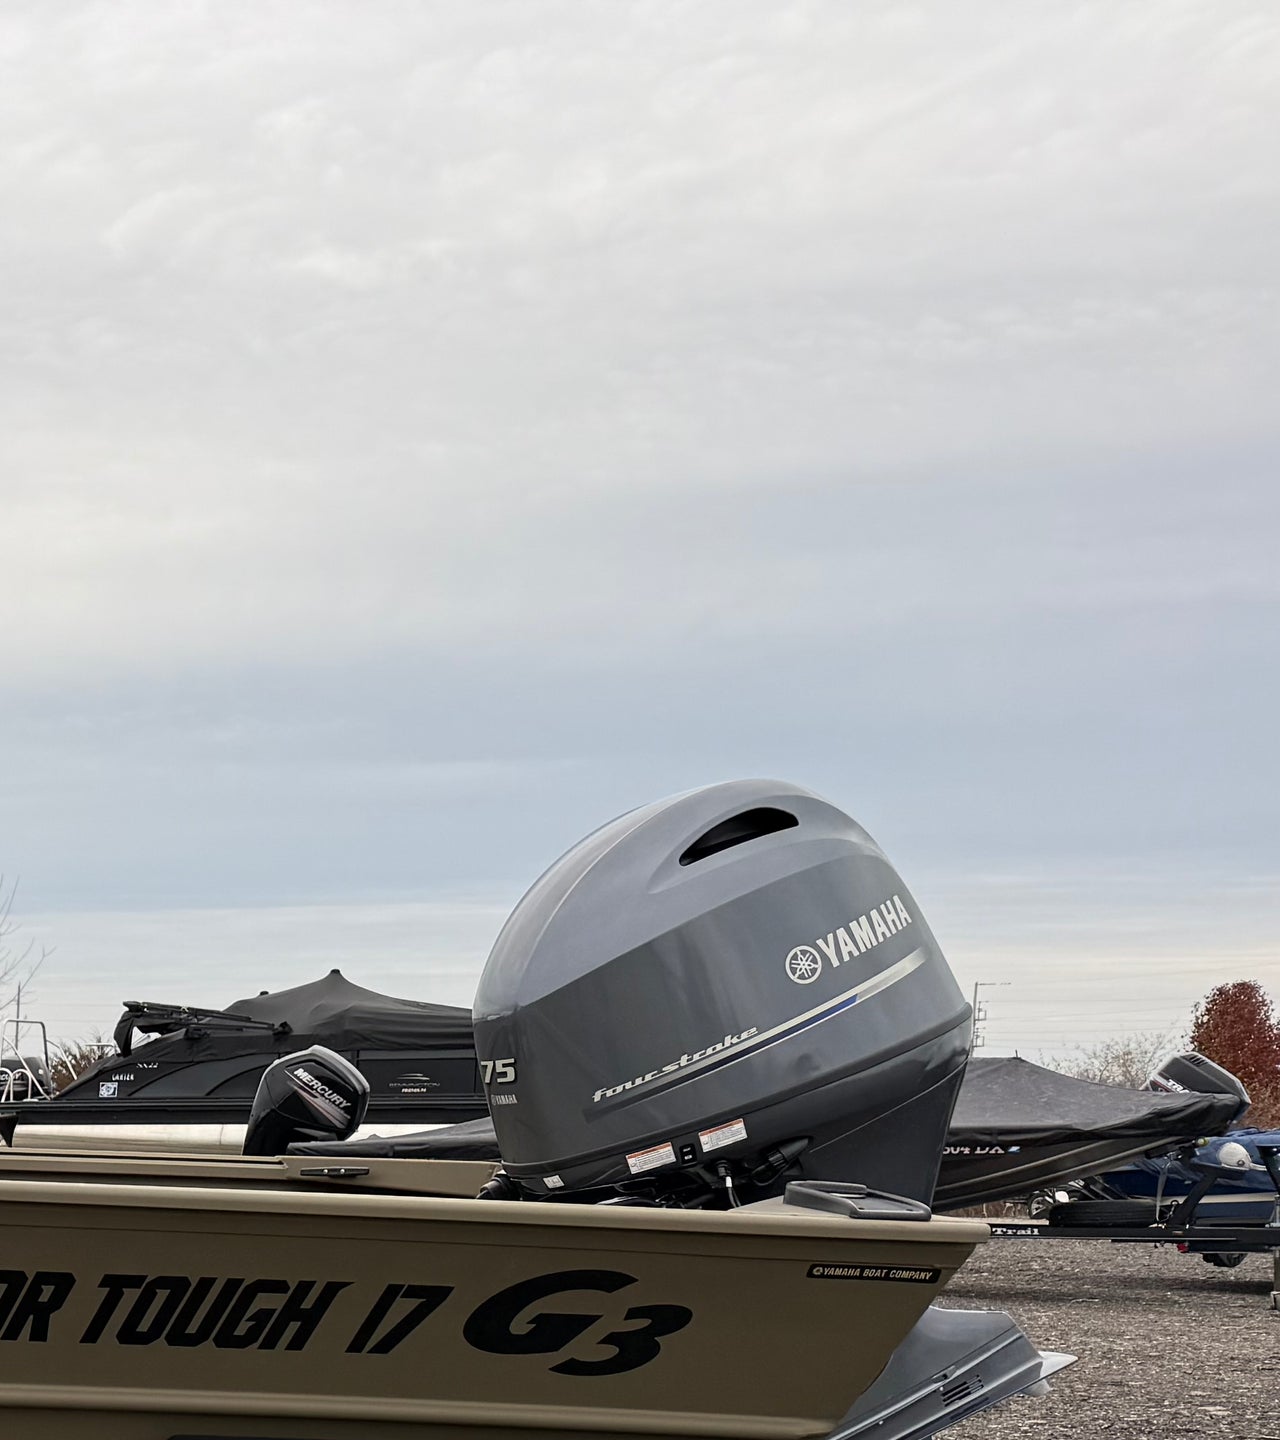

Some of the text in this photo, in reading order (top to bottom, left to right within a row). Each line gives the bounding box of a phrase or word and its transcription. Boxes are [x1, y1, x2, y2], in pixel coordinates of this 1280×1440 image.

[816, 895, 913, 968] YAMAHA
[480, 1058, 516, 1083] 75
[293, 1068, 352, 1108] MERCURY
[992, 1227, 1040, 1236] Trail
[823, 1267, 933, 1281] YAMAHA BOAT COMPANY
[79, 1274, 356, 1352] TOUGH
[344, 1283, 455, 1355] 17
[462, 1269, 693, 1377] G3
